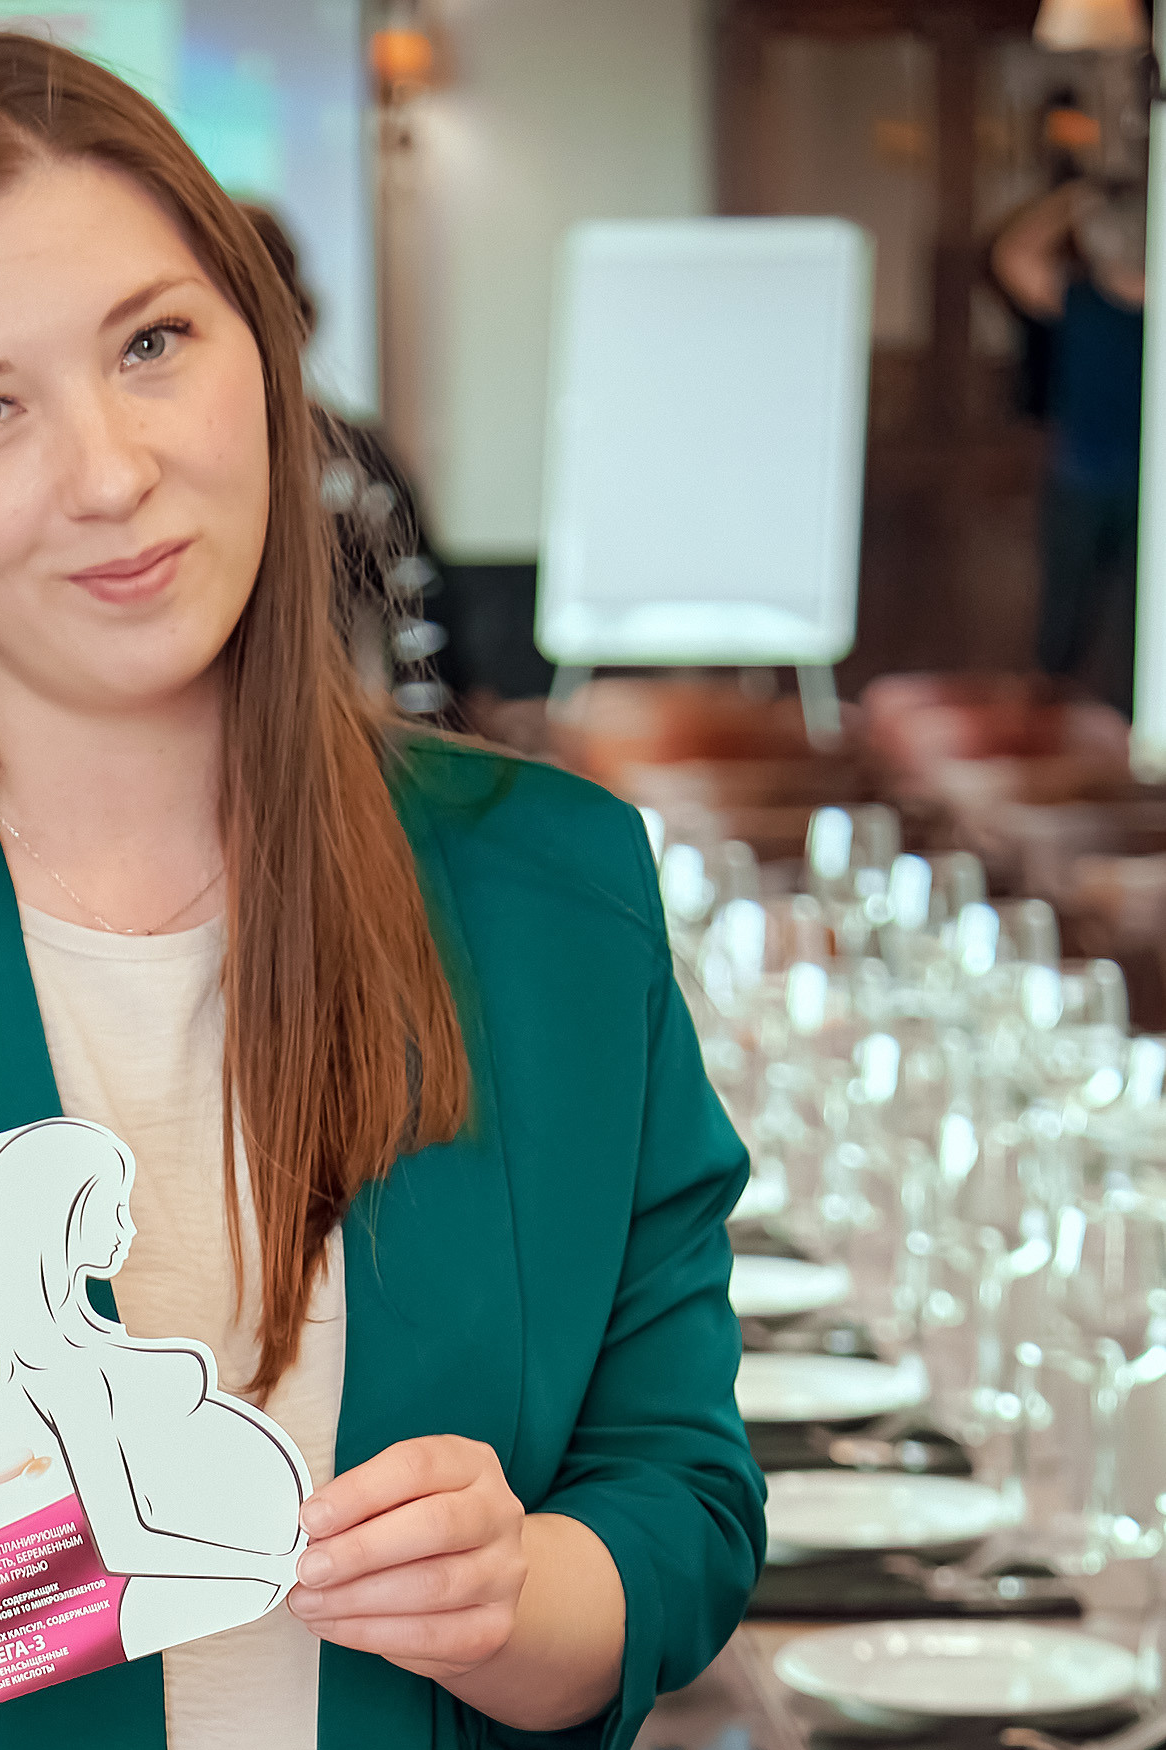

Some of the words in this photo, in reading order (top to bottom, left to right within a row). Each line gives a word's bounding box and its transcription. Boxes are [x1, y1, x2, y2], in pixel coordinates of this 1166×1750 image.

[16, 1534, 84, 1565] БЕРЕМЕННЫМ
[10, 1560, 49, 1583] ГРУДЬЮ
[2, 1582, 60, 1608] СОДЕРЖАЩИХ
[21, 1603, 31, 1614] 10
[32, 1579, 107, 1611] МИКРОЭЛЕМЕНТОВ
[7, 1620, 46, 1641] КАПСУЛ,
[46, 1599, 111, 1628] СОДЕРЖАЩИХ
[11, 1662, 56, 1686] КИСЛОТЫ
